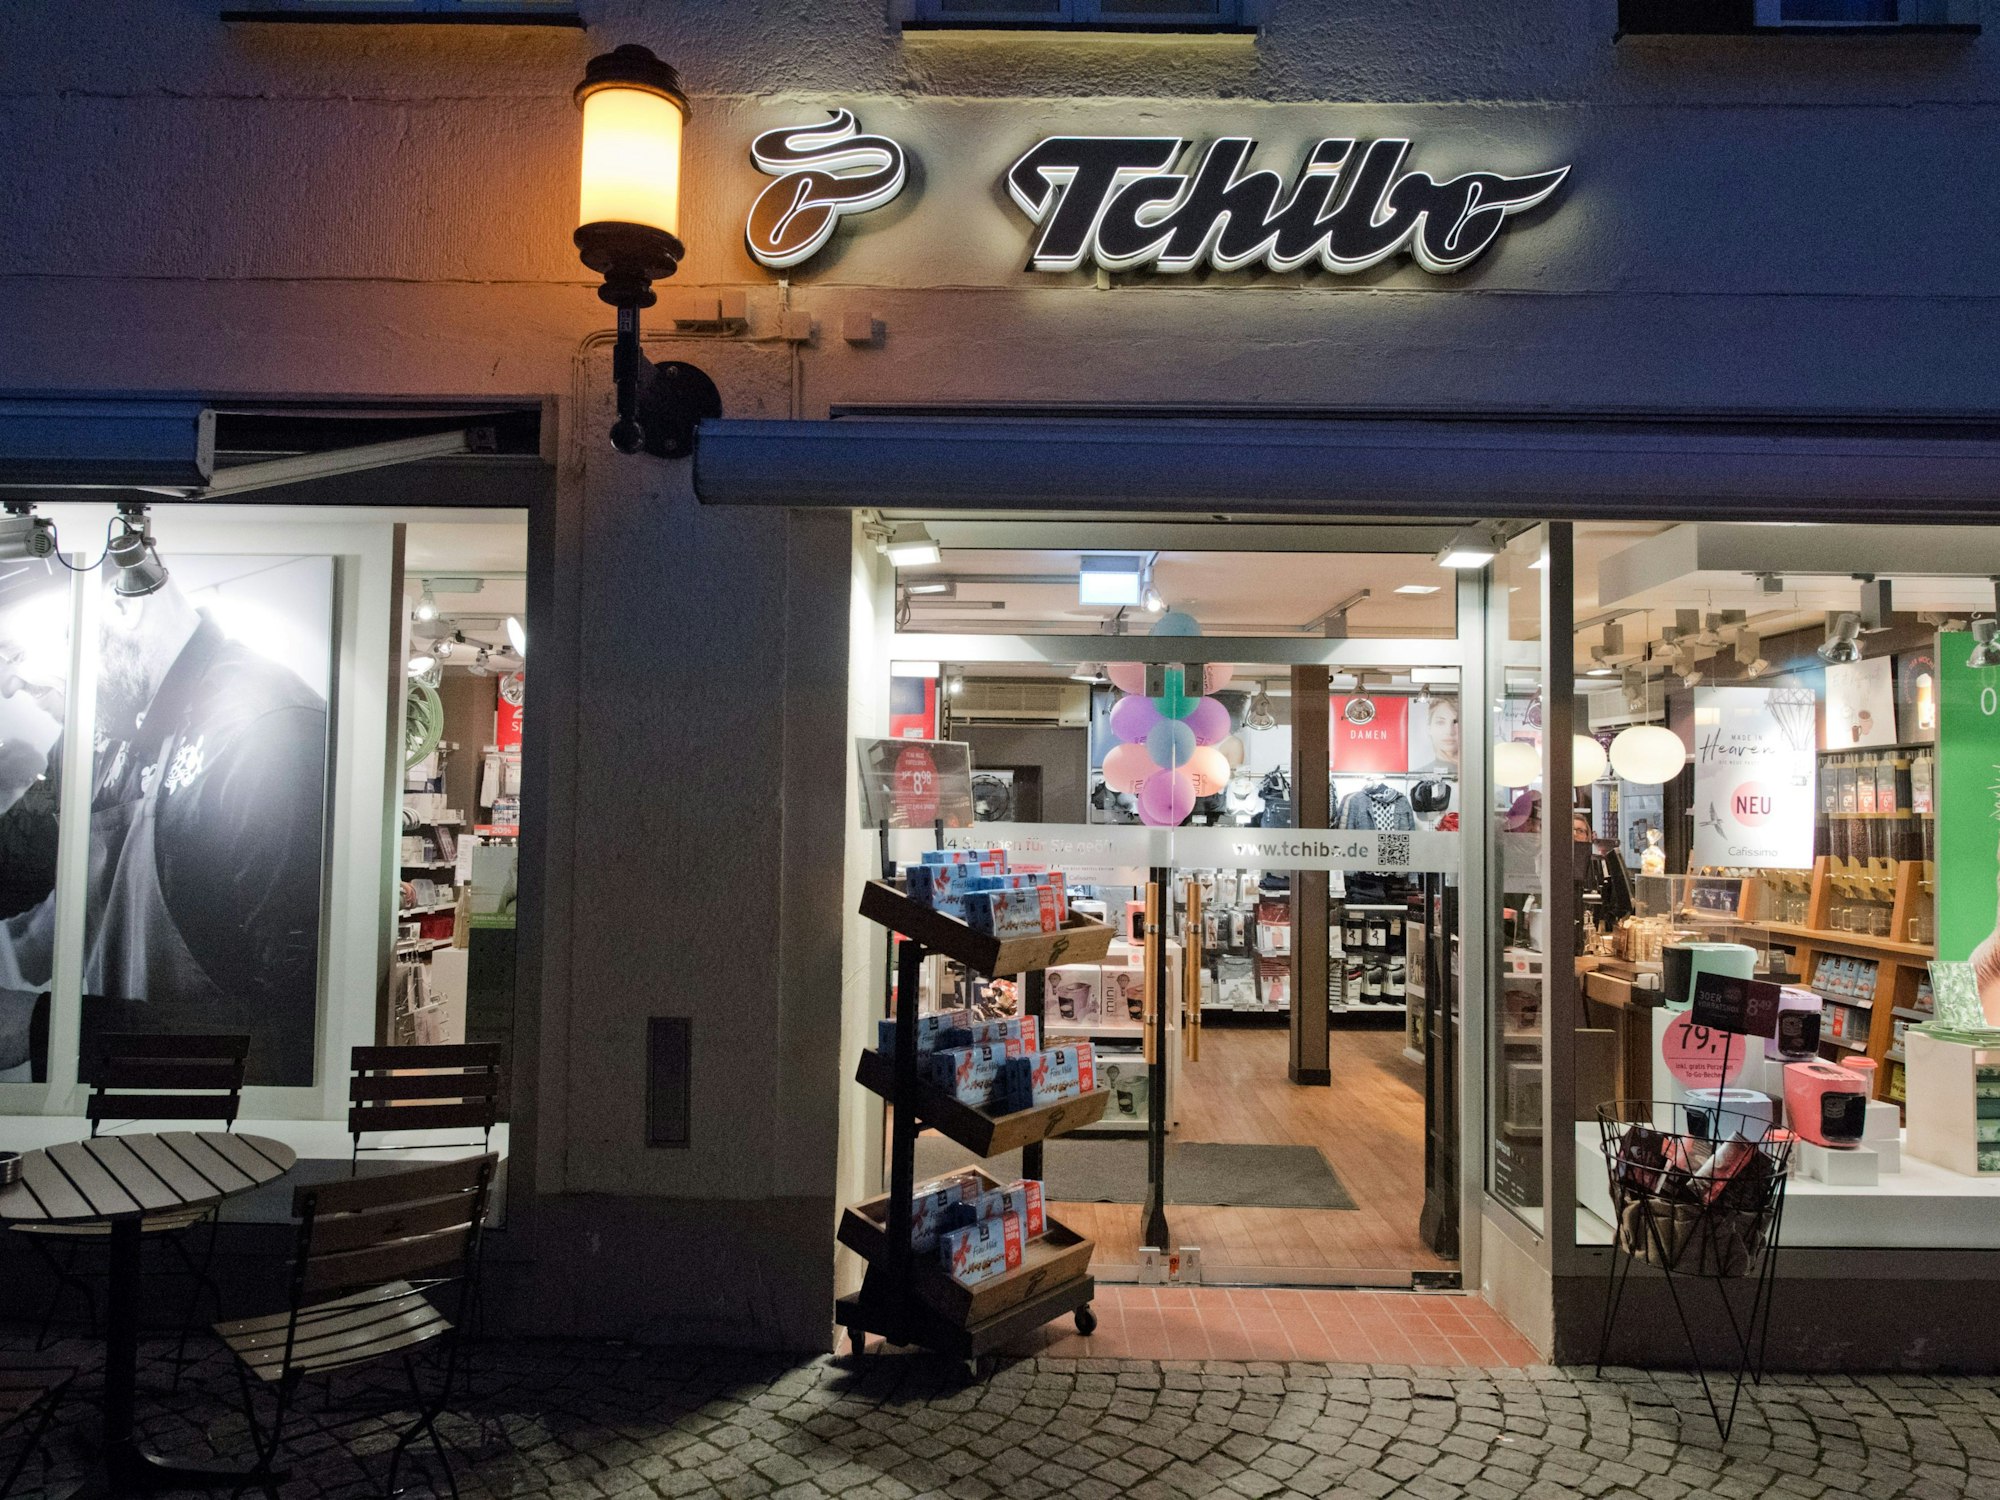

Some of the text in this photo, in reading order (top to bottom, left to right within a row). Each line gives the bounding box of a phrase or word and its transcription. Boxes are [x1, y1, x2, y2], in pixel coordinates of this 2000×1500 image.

[1008, 135, 1572, 275] Tchibo
[1349, 729, 1387, 741] DAMEN
[1699, 727, 1775, 764] Heaven
[1736, 796, 1771, 815] NEU
[1231, 841, 1369, 858] www.tchibo.de
[1728, 846, 1778, 857] Cafissimo
[1689, 1063, 1706, 1071] gratis
